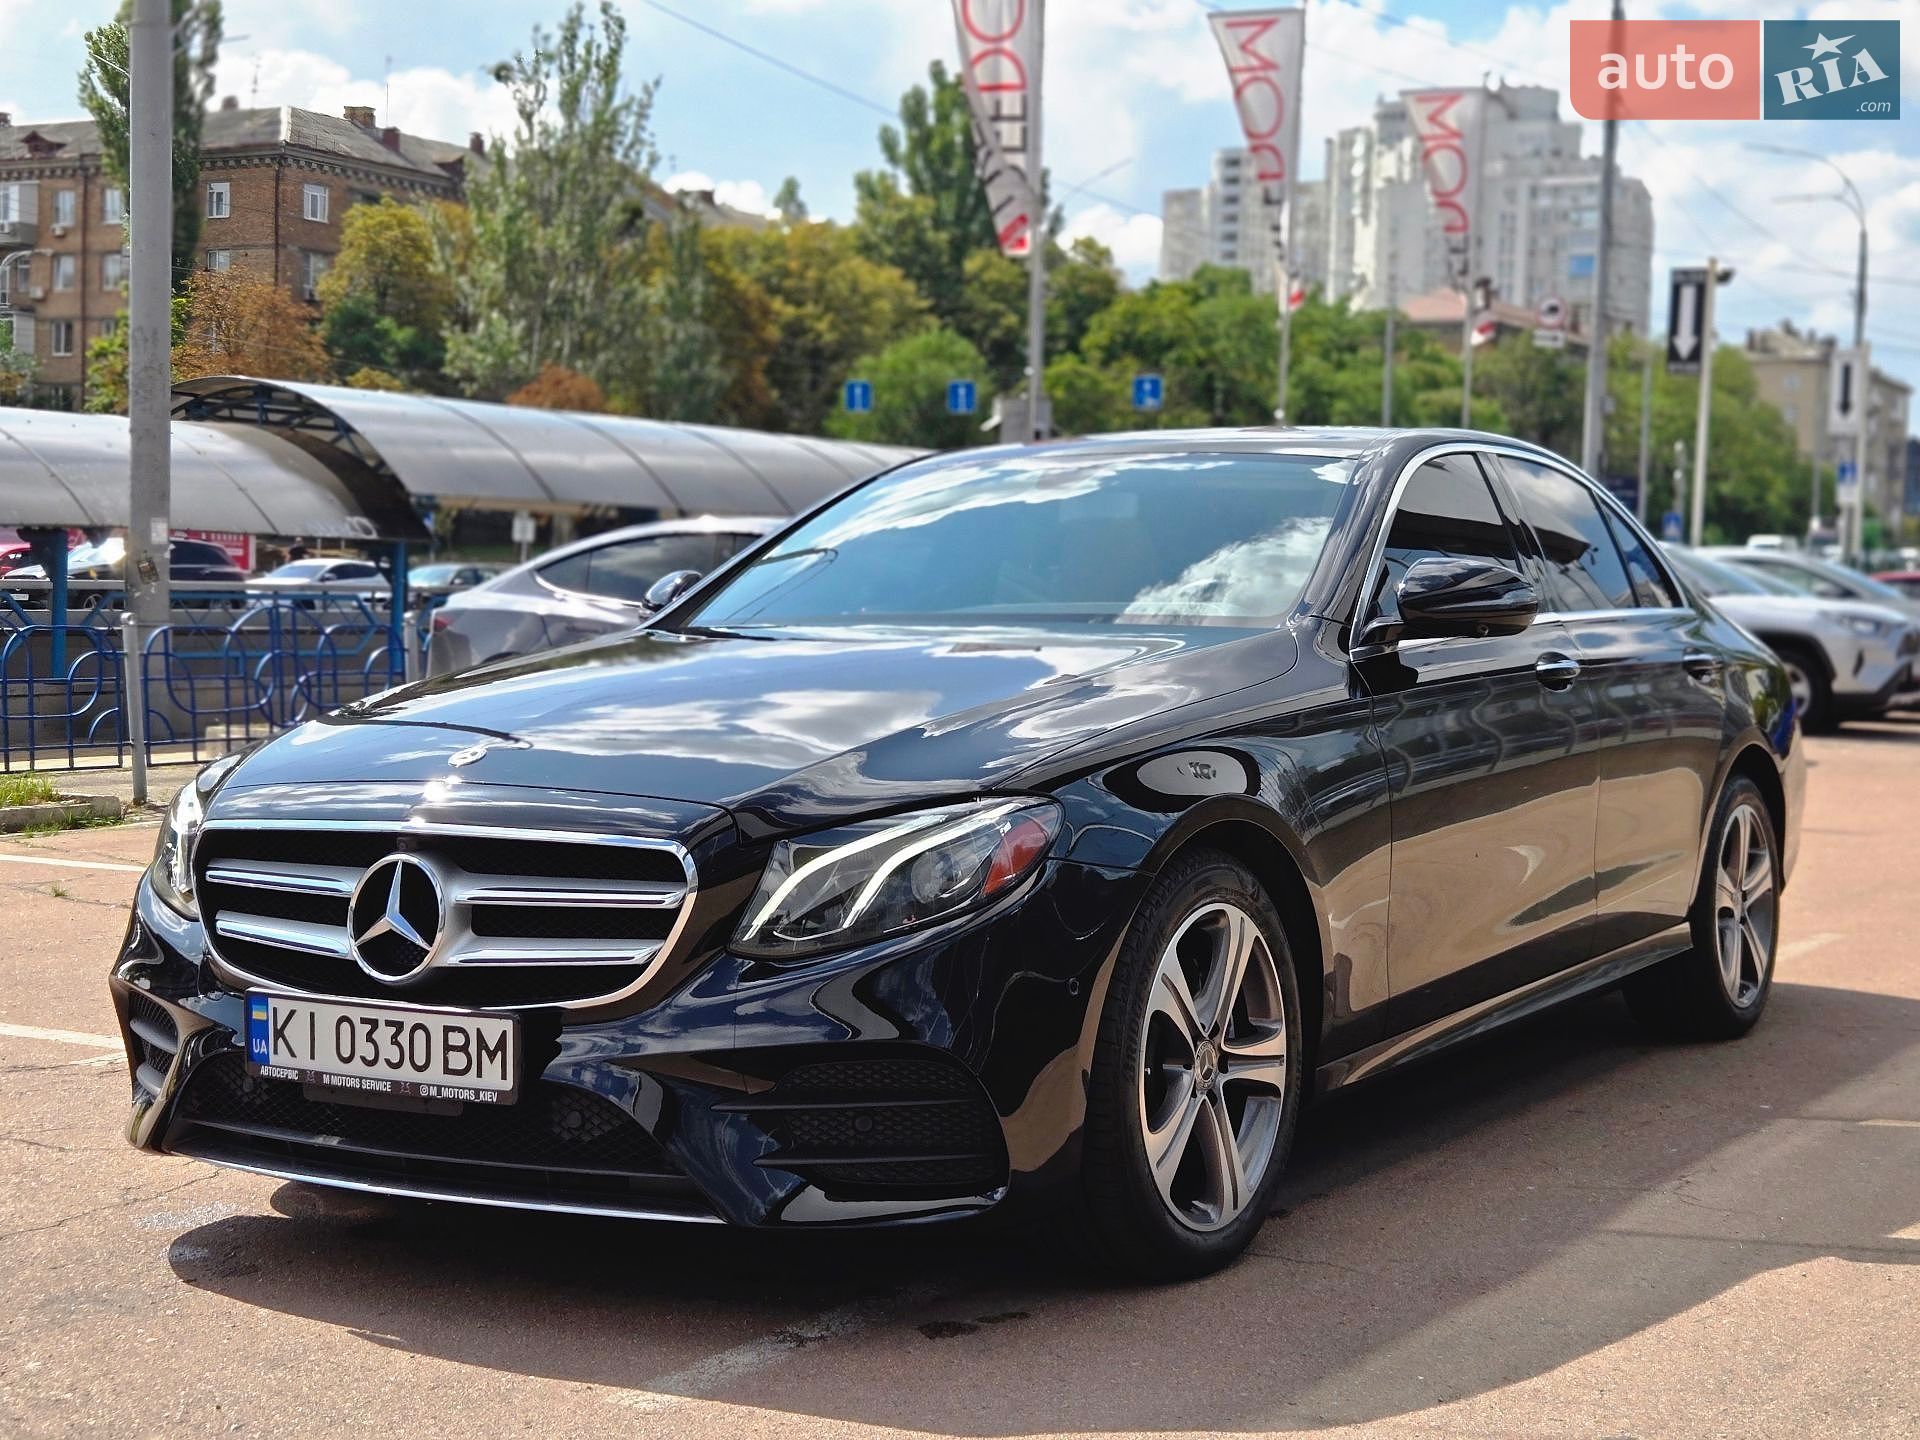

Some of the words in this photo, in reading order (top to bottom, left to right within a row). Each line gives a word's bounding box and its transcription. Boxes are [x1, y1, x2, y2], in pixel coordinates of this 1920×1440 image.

[252, 1038, 268, 1055] UA
[272, 1006, 316, 1061] KI
[335, 1014, 432, 1073] 0330
[442, 1024, 508, 1081] BM
[323, 1074, 330, 1084] M
[330, 1075, 360, 1089] MOTORS
[361, 1080, 392, 1092] SERVICE
